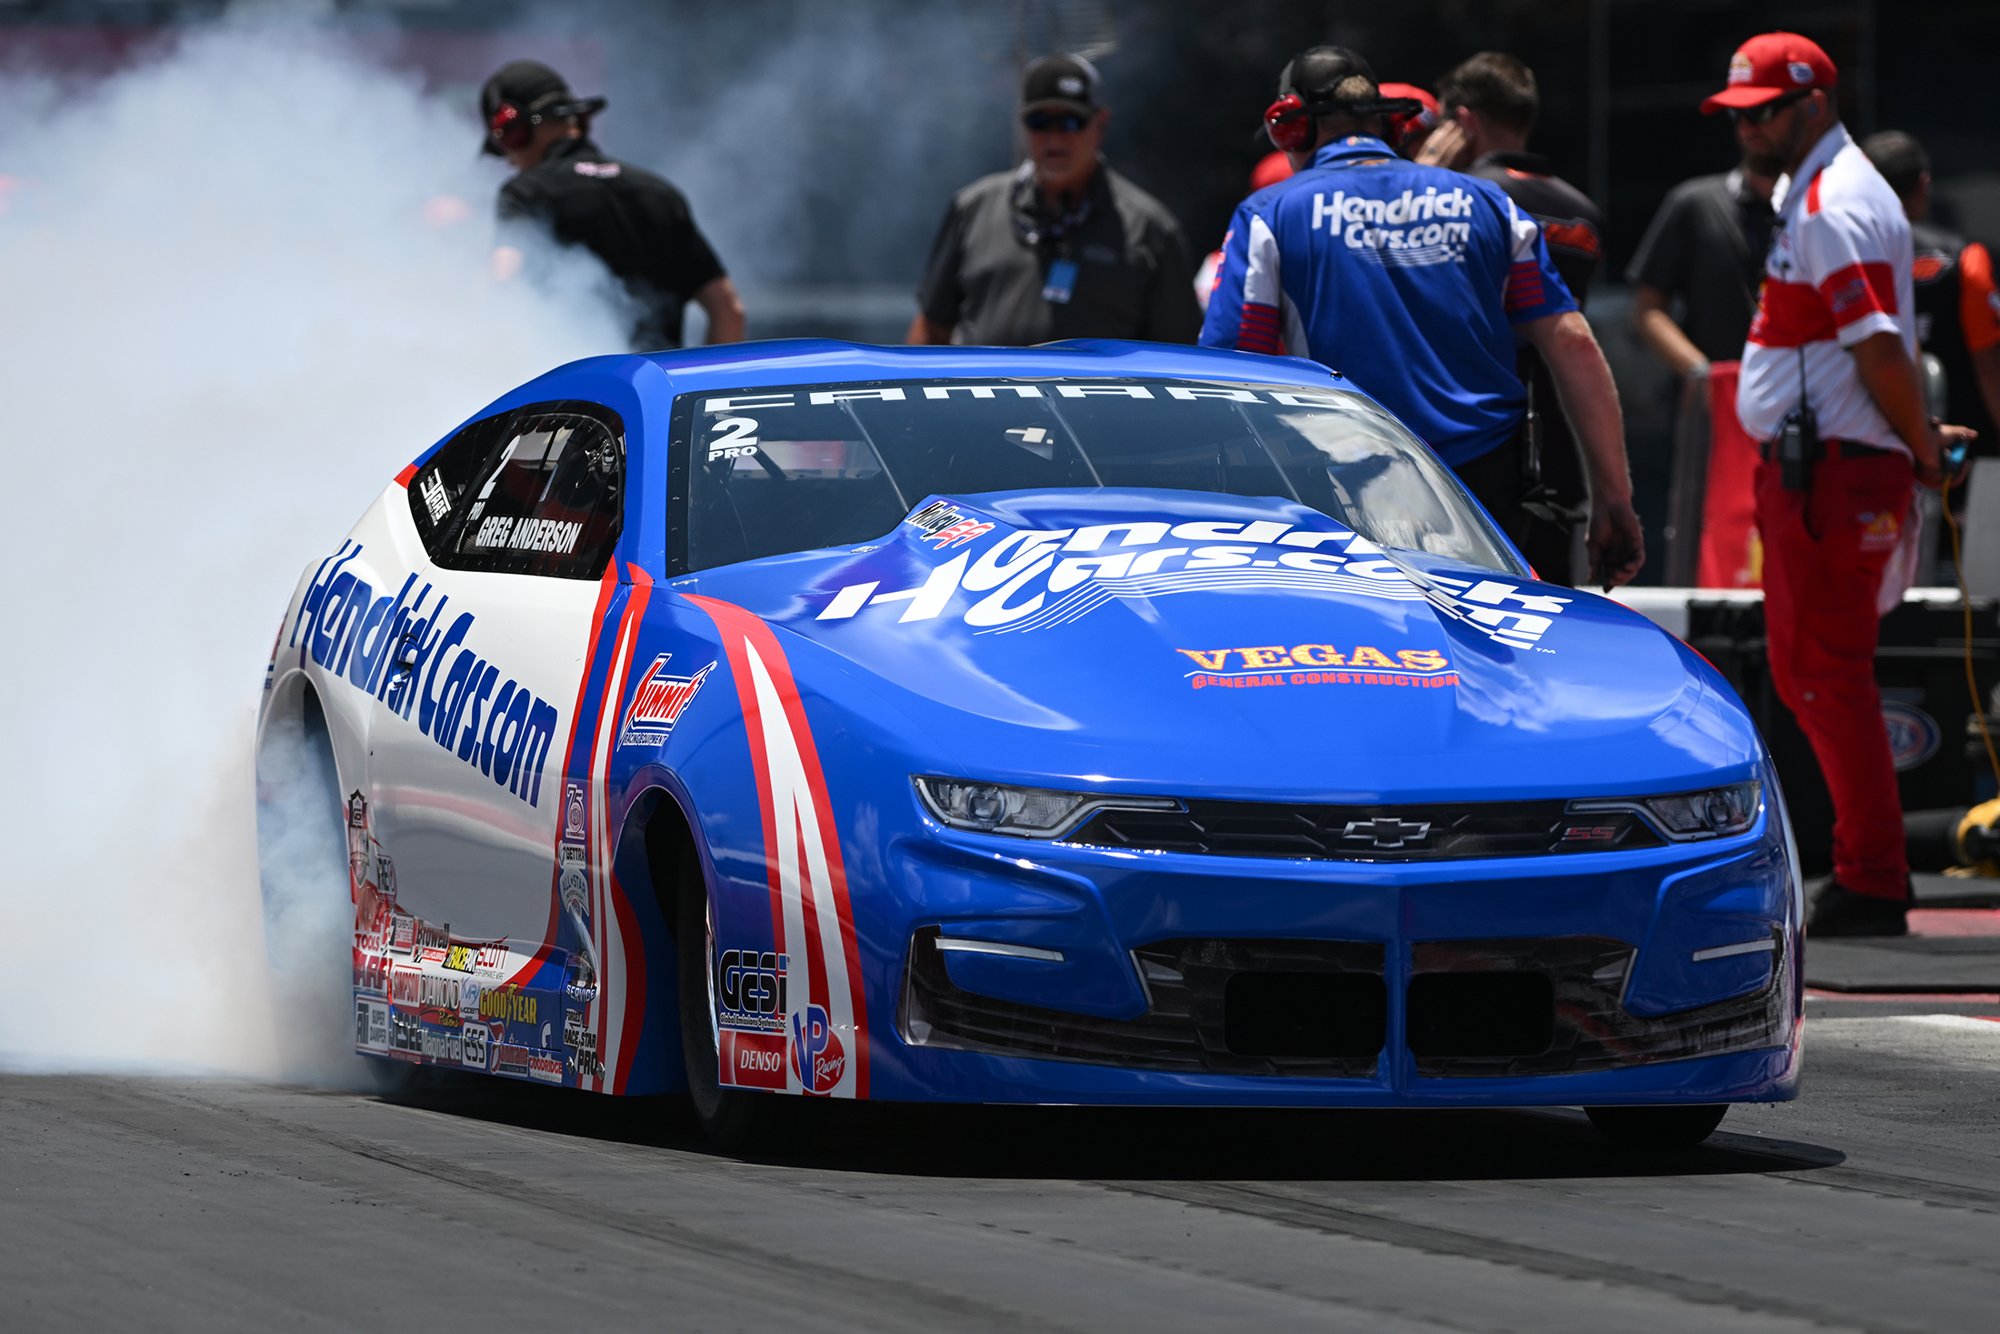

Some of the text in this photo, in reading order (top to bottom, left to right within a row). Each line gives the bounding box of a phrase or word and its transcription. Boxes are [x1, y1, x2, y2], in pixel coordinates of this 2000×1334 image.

[1312, 186, 1473, 236] Hendrick
[1344, 221, 1470, 249] Cars.com
[704, 384, 1364, 412] CAMARO
[709, 417, 759, 450] 2
[477, 434, 521, 500] 2
[708, 446, 758, 461] PRO
[466, 501, 486, 521] PRO
[905, 501, 965, 540] Holley
[475, 515, 583, 554] GREG ANDERSON
[1176, 644, 1448, 671] VEGAS
[1192, 672, 1470, 689] GENERAL CONSTRUCTION
[620, 653, 718, 738] SUMMIT
[476, 942, 510, 969] SCOTT
[421, 975, 460, 1011] DIAMOND
[566, 984, 596, 1002] SERVICE
[720, 1013, 735, 1024] Global
[421, 1028, 461, 1063] MagnaFuel
[564, 1028, 597, 1049] RACE STAR
[792, 1004, 829, 1093] VP
[529, 1056, 562, 1074] GOODRIDGE
[577, 1049, 599, 1076] PRO
[740, 1050, 780, 1072] DENSO
[816, 1055, 845, 1083] Racing
